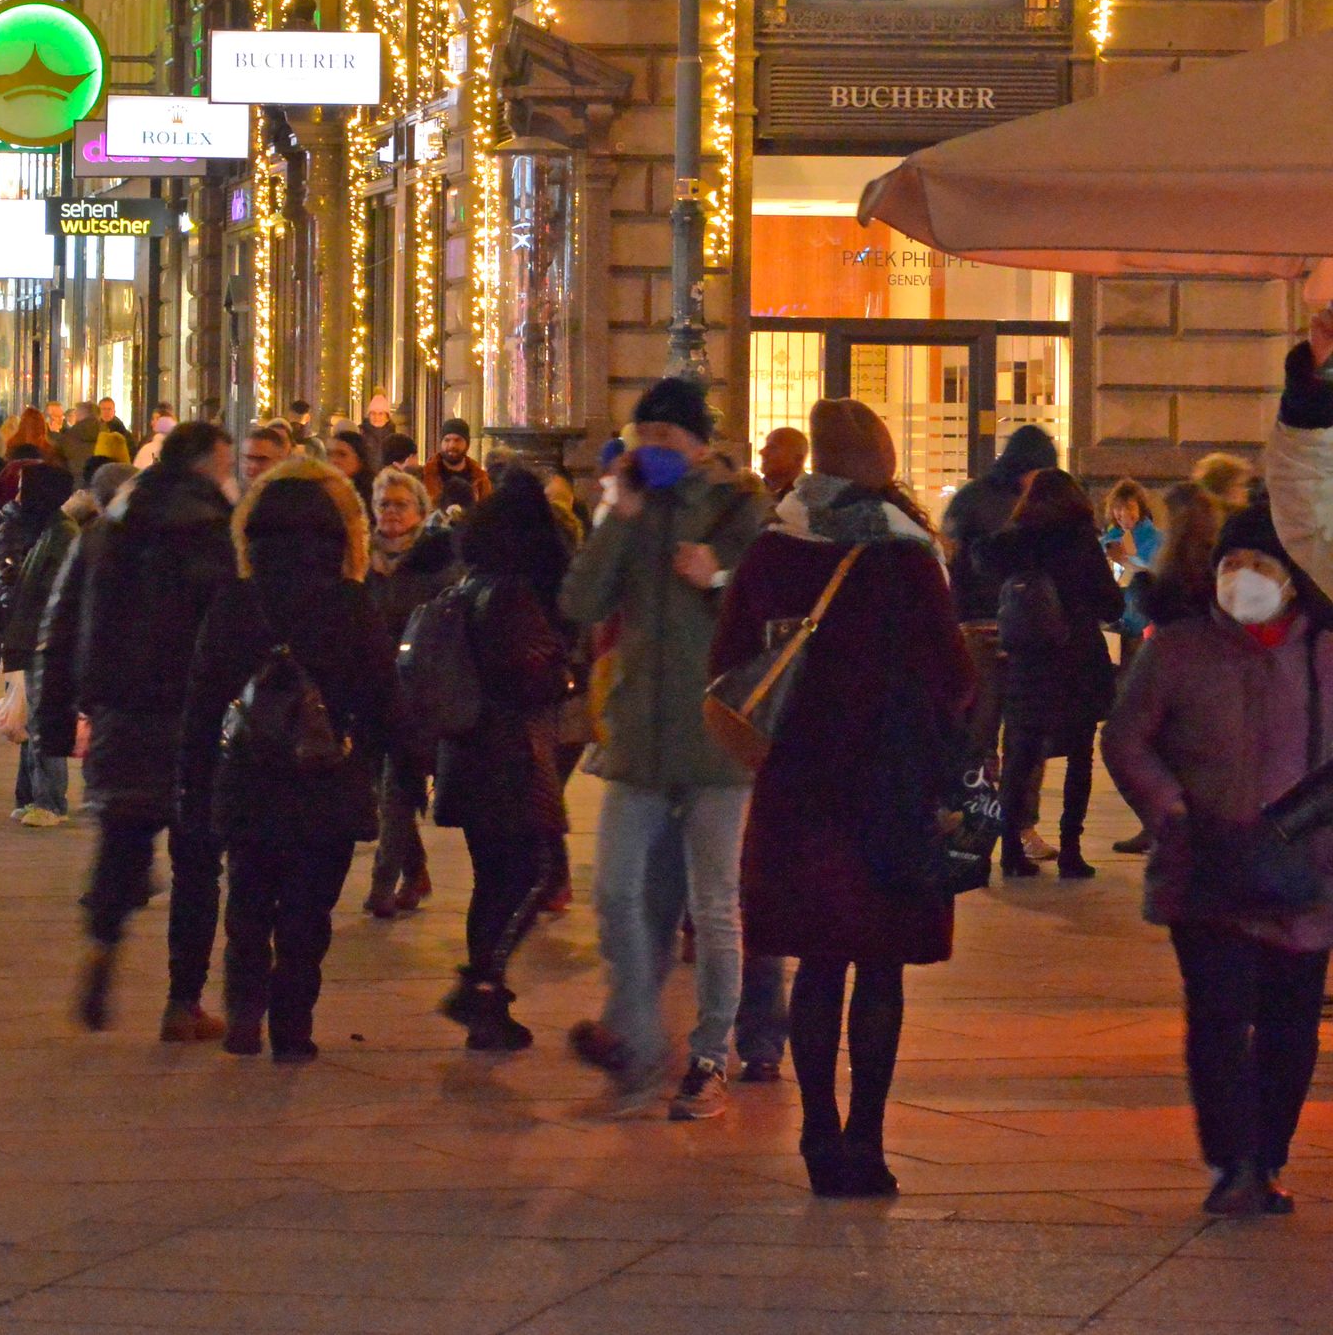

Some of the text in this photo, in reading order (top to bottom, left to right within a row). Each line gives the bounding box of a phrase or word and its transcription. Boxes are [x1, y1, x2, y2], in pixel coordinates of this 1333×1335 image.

[235, 53, 356, 70] BUCHERER
[832, 86, 996, 109] BUCHERER
[142, 131, 212, 146] ROLEX
[61, 200, 118, 218] sehen!
[61, 218, 151, 235] wutscher
[842, 251, 980, 269] PATEK PHILIPPE
[888, 274, 934, 286] GENEVE
